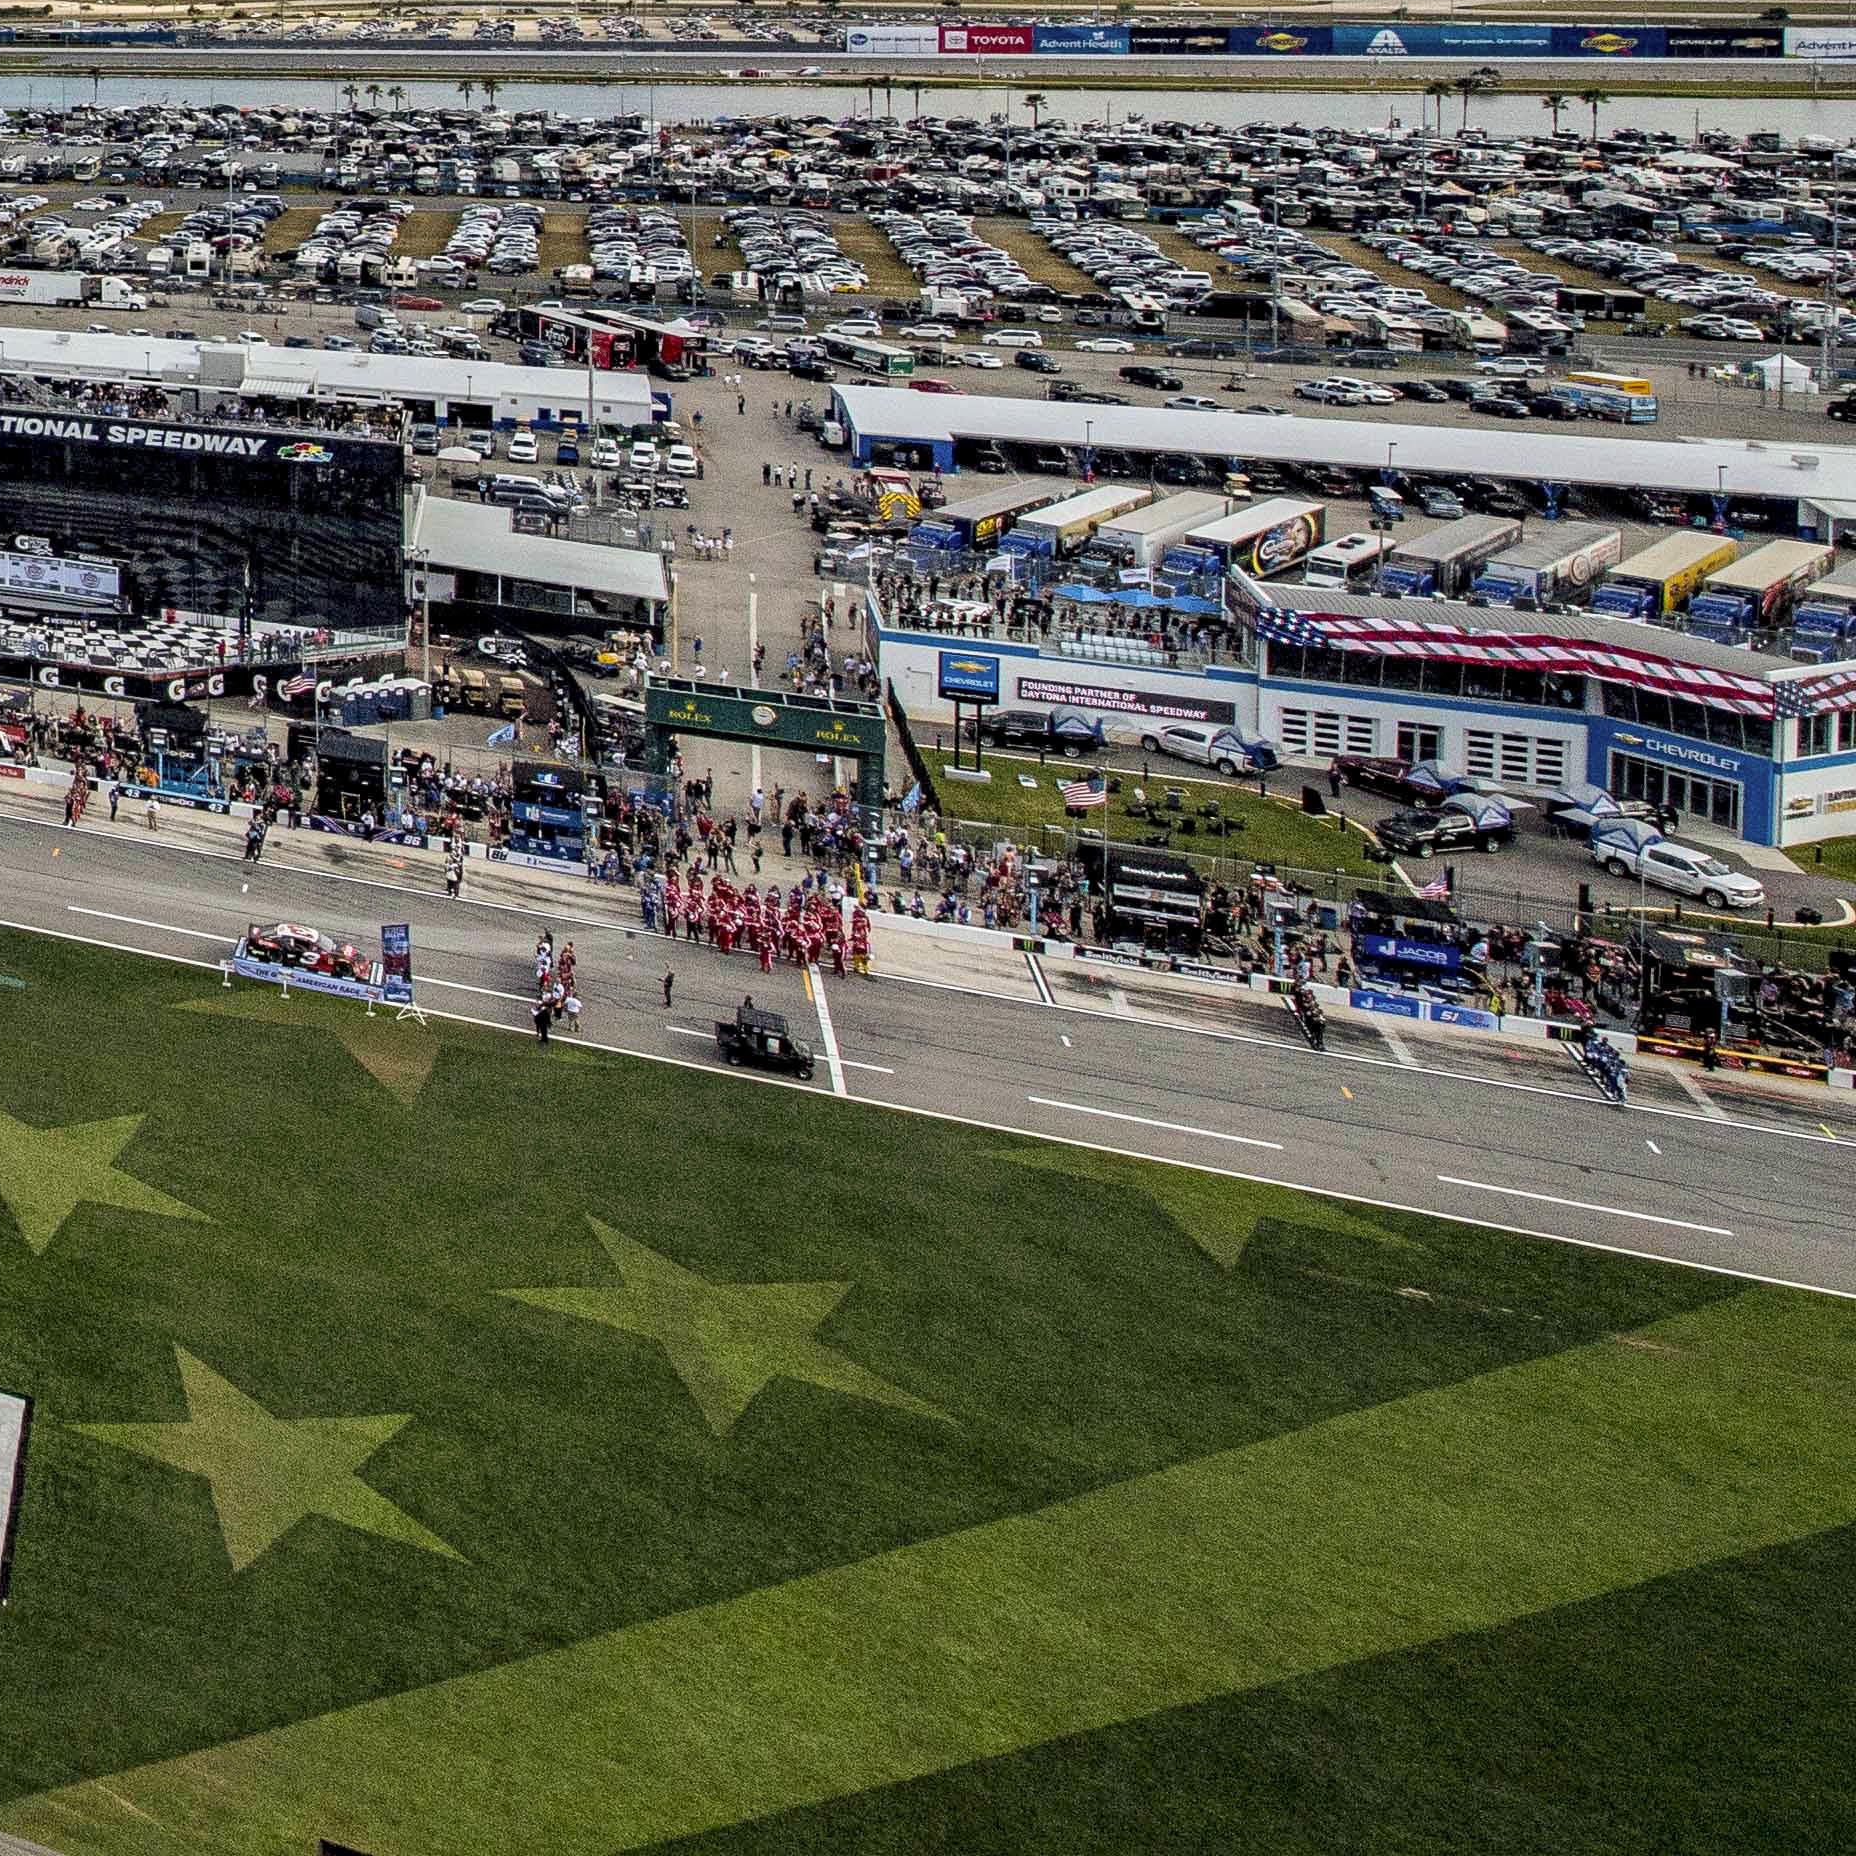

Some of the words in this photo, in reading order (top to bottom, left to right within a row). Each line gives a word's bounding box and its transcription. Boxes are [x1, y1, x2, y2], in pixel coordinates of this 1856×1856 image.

[971, 35, 1025, 45] TOYOTA
[1039, 39, 1122, 49] AdventHealth
[106, 425, 268, 456] SPEEDWAY
[15, 534, 30, 550] G
[478, 637, 497, 654] G
[39, 666, 59, 686] G
[208, 673, 224, 695] G
[943, 676, 994, 689] CHEVROLET
[104, 676, 125, 695] G
[168, 679, 185, 702] G
[1021, 680, 1072, 695] FOUNDING
[1074, 686, 1121, 700] PARTNER
[1122, 693, 1137, 702] OF
[1021, 689, 1067, 704] DAYTONA
[1068, 696, 1148, 713] INTERNATIONAL
[1149, 704, 1208, 720] SPEEDWAY
[669, 710, 712, 724] ROLEX
[816, 730, 862, 744] ROLEX
[1646, 738, 1741, 772] CHEVROLET
[208, 803, 225, 813] 43
[403, 834, 421, 847] 96
[300, 952, 320, 965] 3
[1085, 950, 1140, 966] Smithfield
[1397, 945, 1448, 961] JACOB
[1180, 967, 1238, 982] Smithfield
[296, 977, 339, 991] AMERICAN
